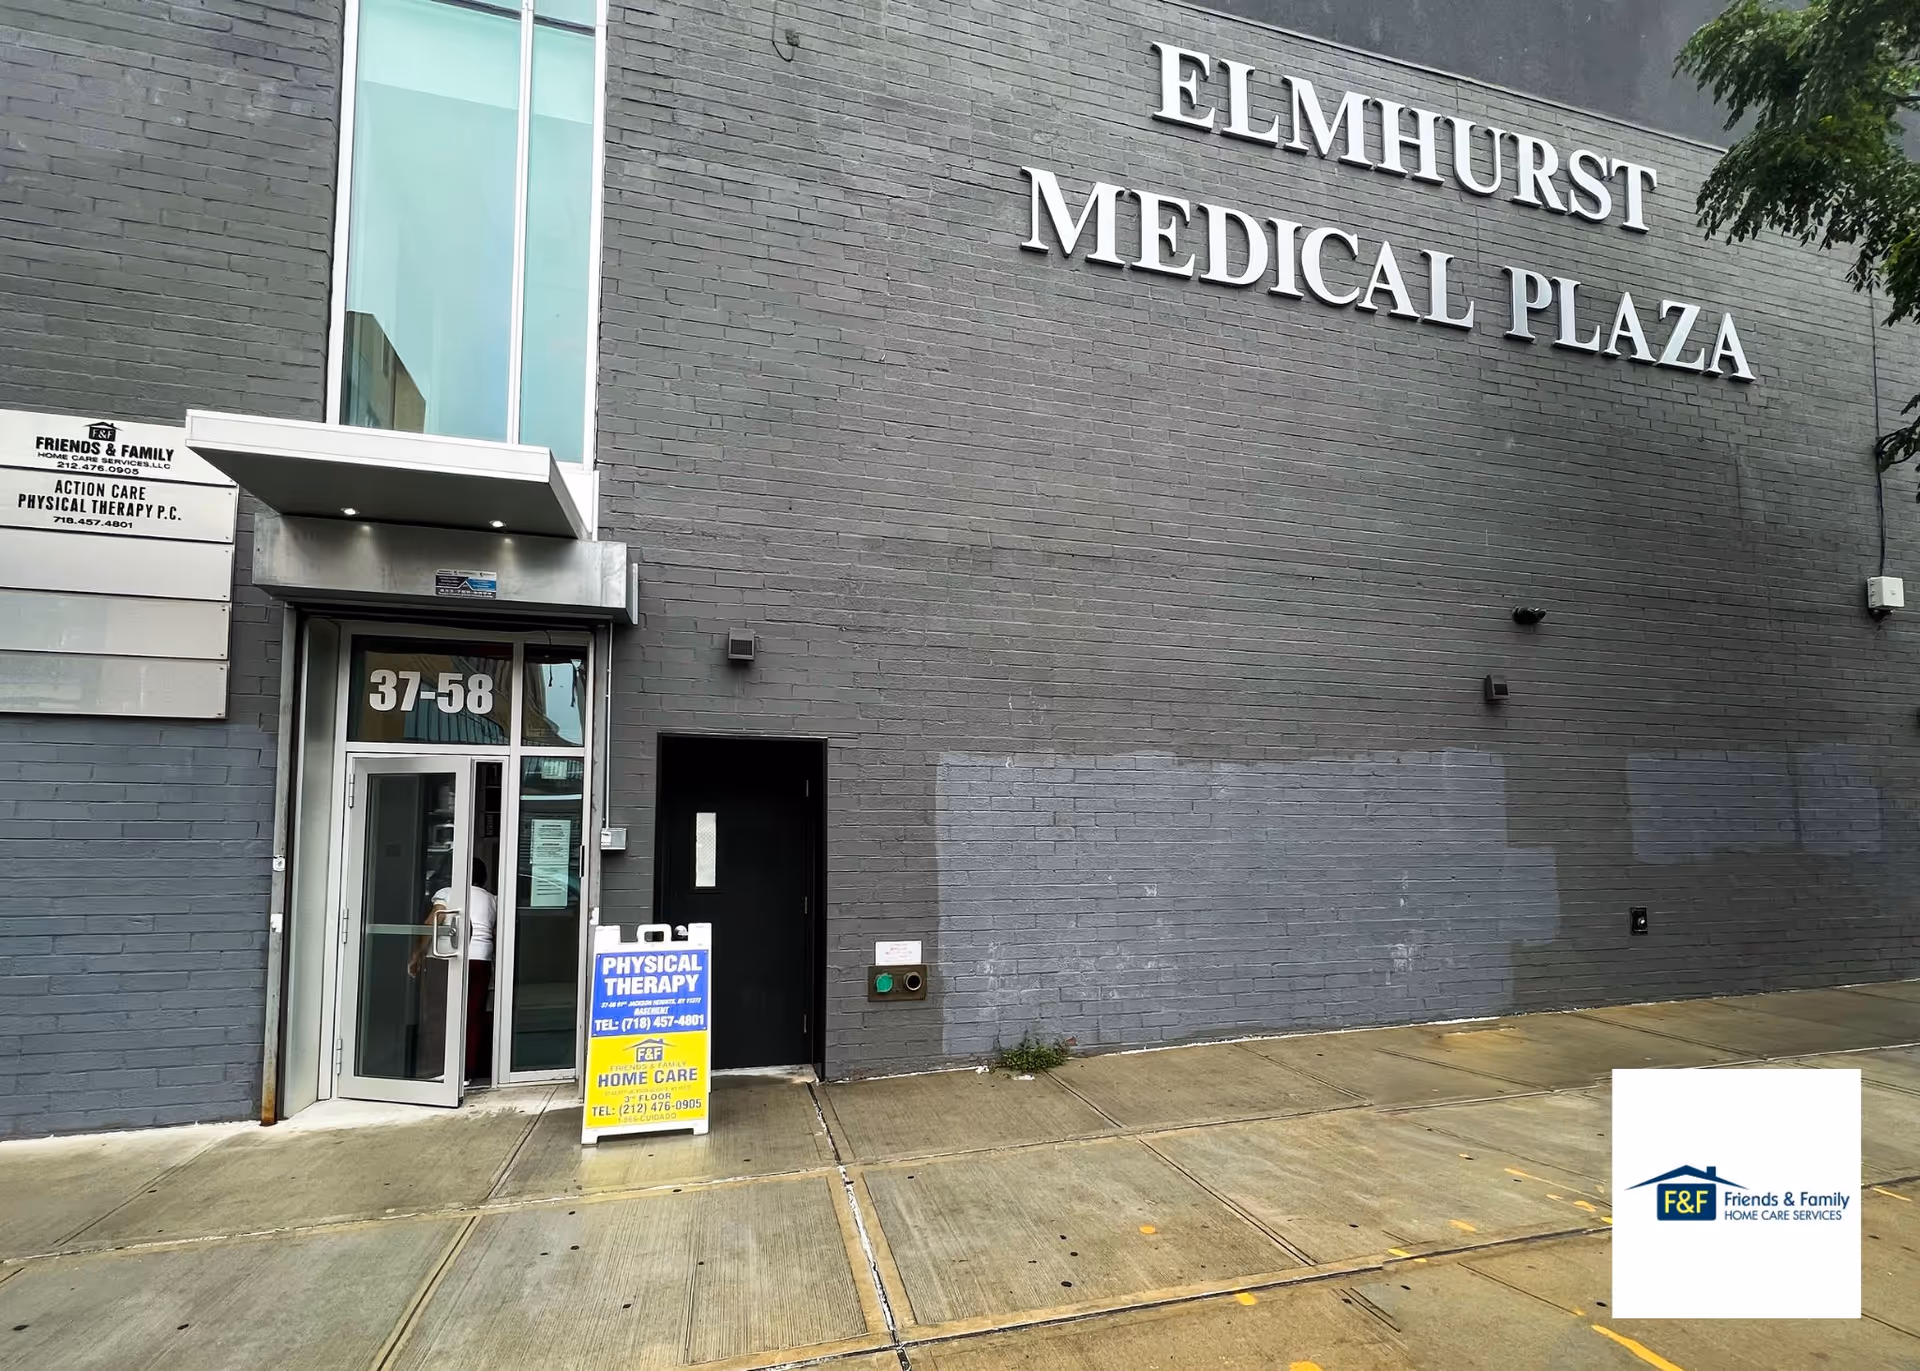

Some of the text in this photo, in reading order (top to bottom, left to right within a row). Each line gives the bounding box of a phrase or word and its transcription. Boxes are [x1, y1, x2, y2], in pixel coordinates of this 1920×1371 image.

[1151, 41, 1658, 234] ELMHURST
[1020, 166, 1756, 383] MEDICAL PLAZA
[91, 428, 113, 440] F&F
[35, 436, 175, 462] FRIENDS & FAMILY
[37, 451, 68, 461] HOME
[71, 454, 98, 463] CARE
[56, 461, 140, 475] 212.476.0905
[54, 479, 147, 501] ACTION CARE
[17, 493, 182, 521] PHYSICAL THERAPY P.C.
[52, 516, 133, 529] 718.457.4801
[368, 669, 493, 715] 37-58
[602, 954, 703, 975] PHYSICAL
[604, 974, 699, 996] THERAPY
[594, 1014, 705, 1032] TEL: (718) 457-4801
[637, 1047, 662, 1062] F&F
[610, 1063, 647, 1072] FRIENDS
[657, 1061, 687, 1069] FAMILY
[598, 1068, 698, 1088] HOME CARE
[638, 1092, 672, 1101] FLOOR
[592, 1098, 702, 1117] TEL: (212) 476-0905
